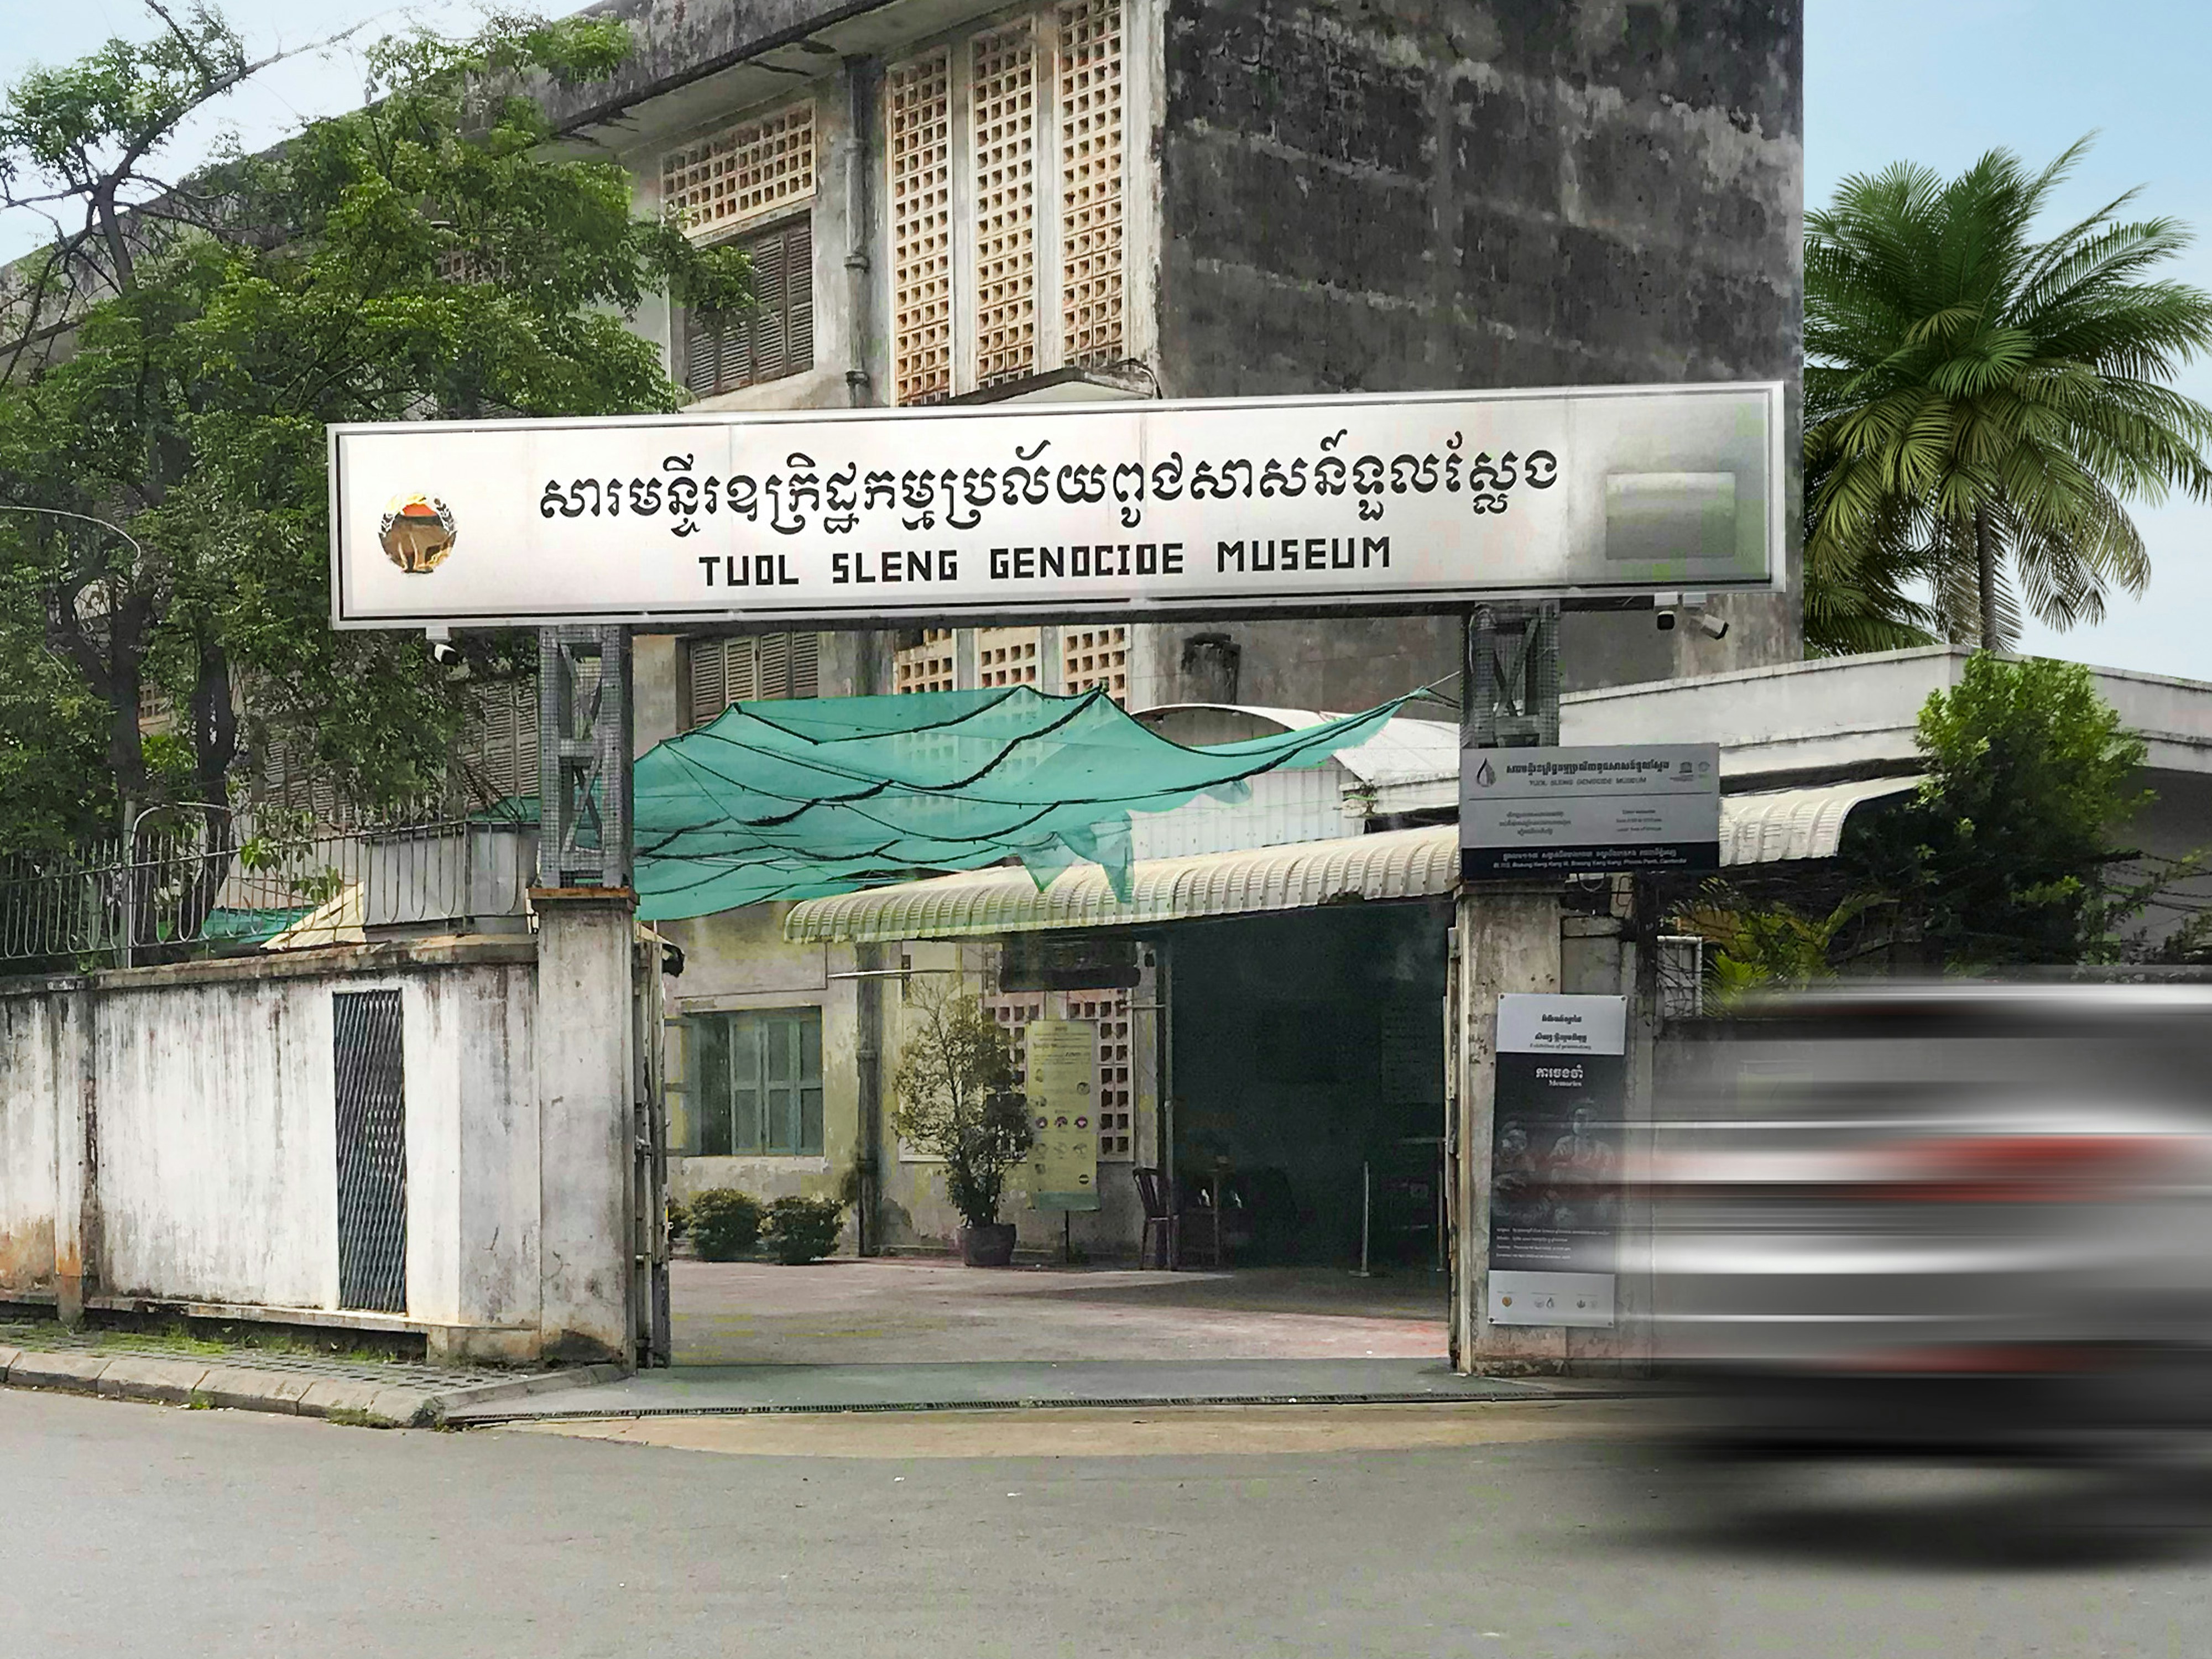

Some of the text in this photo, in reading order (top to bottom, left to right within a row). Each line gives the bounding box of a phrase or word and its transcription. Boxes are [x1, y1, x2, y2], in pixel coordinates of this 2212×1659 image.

[700, 555, 800, 587] TUOL
[832, 549, 957, 583] SLENG
[1217, 536, 1390, 573] MUSEUM
